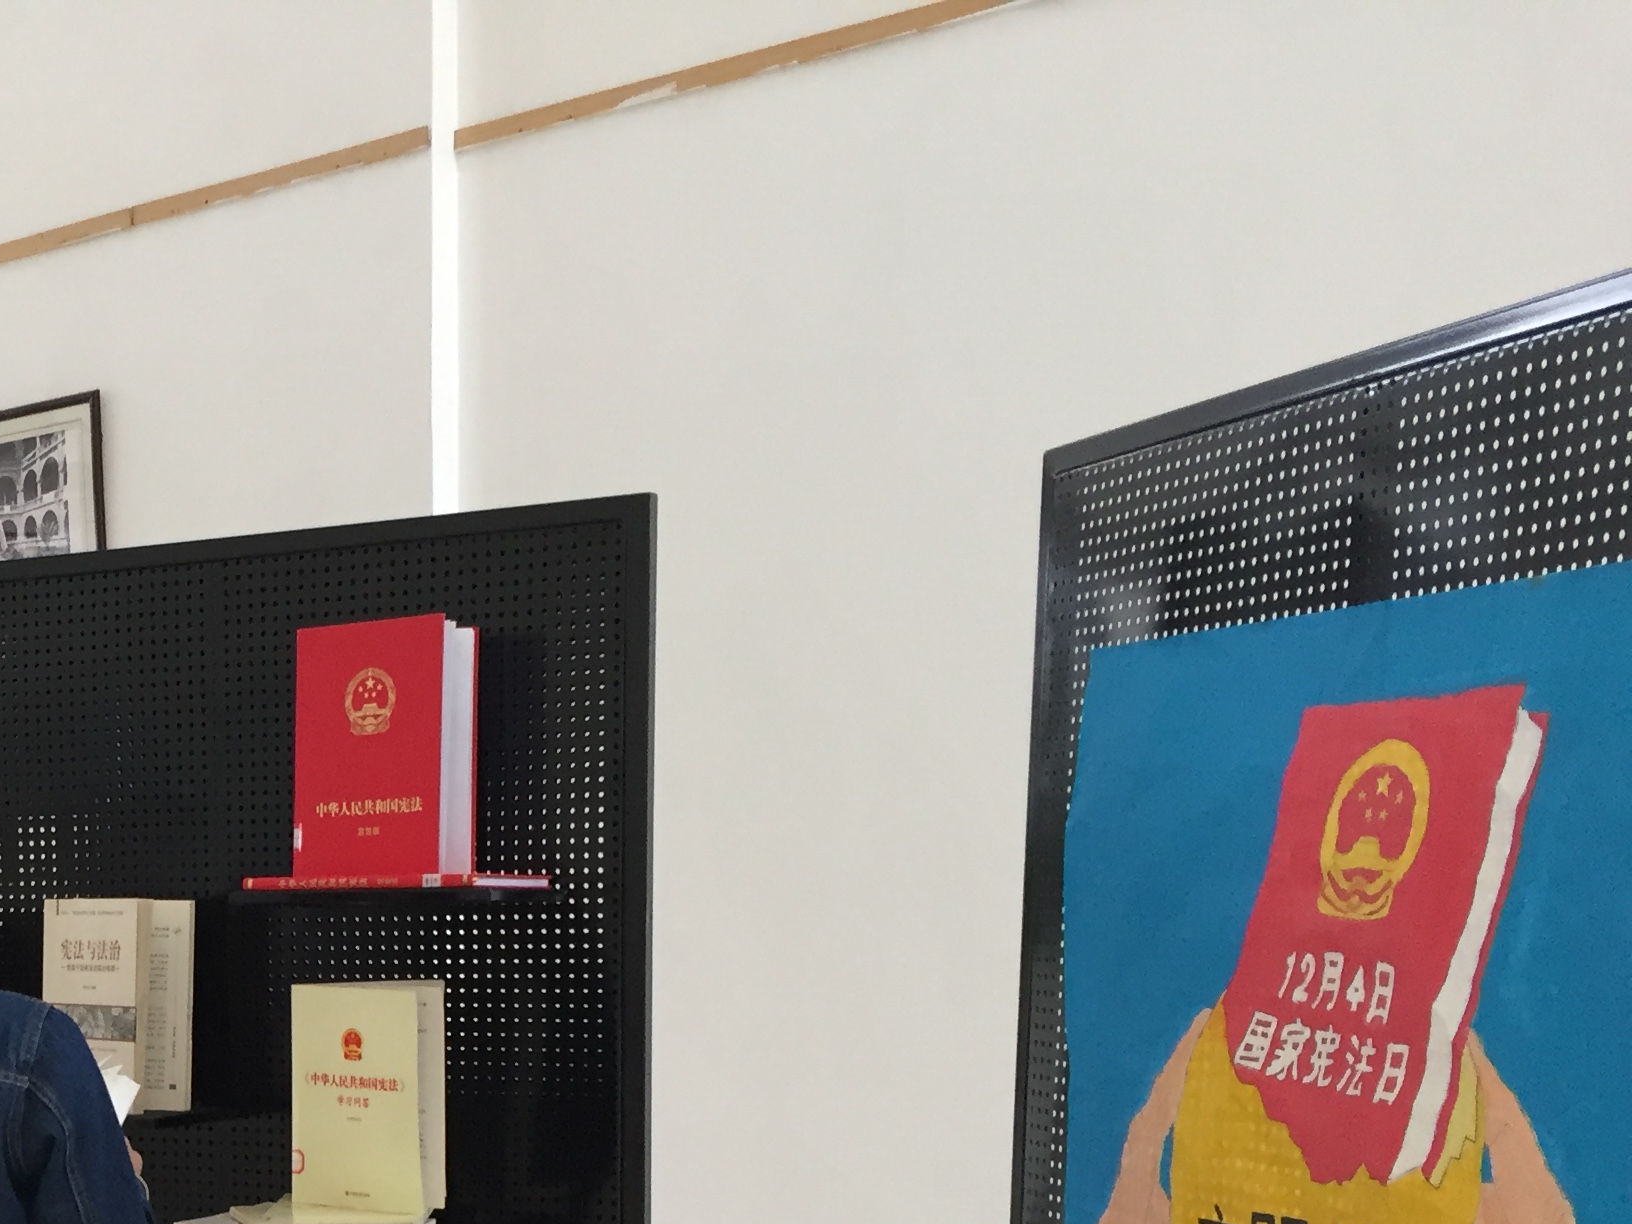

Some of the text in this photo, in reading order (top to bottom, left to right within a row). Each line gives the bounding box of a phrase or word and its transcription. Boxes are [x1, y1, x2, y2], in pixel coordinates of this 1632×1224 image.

[316, 797, 423, 818] 中华人民共和国宪法
[61, 939, 121, 961] 宪法与法治
[1277, 950, 1396, 1025] 12月4日
[1233, 1009, 1410, 1107] 国家宪法日
[305, 1072, 405, 1092] 《中华人民共和国宪法》
[337, 1095, 370, 1108] 学习问答
